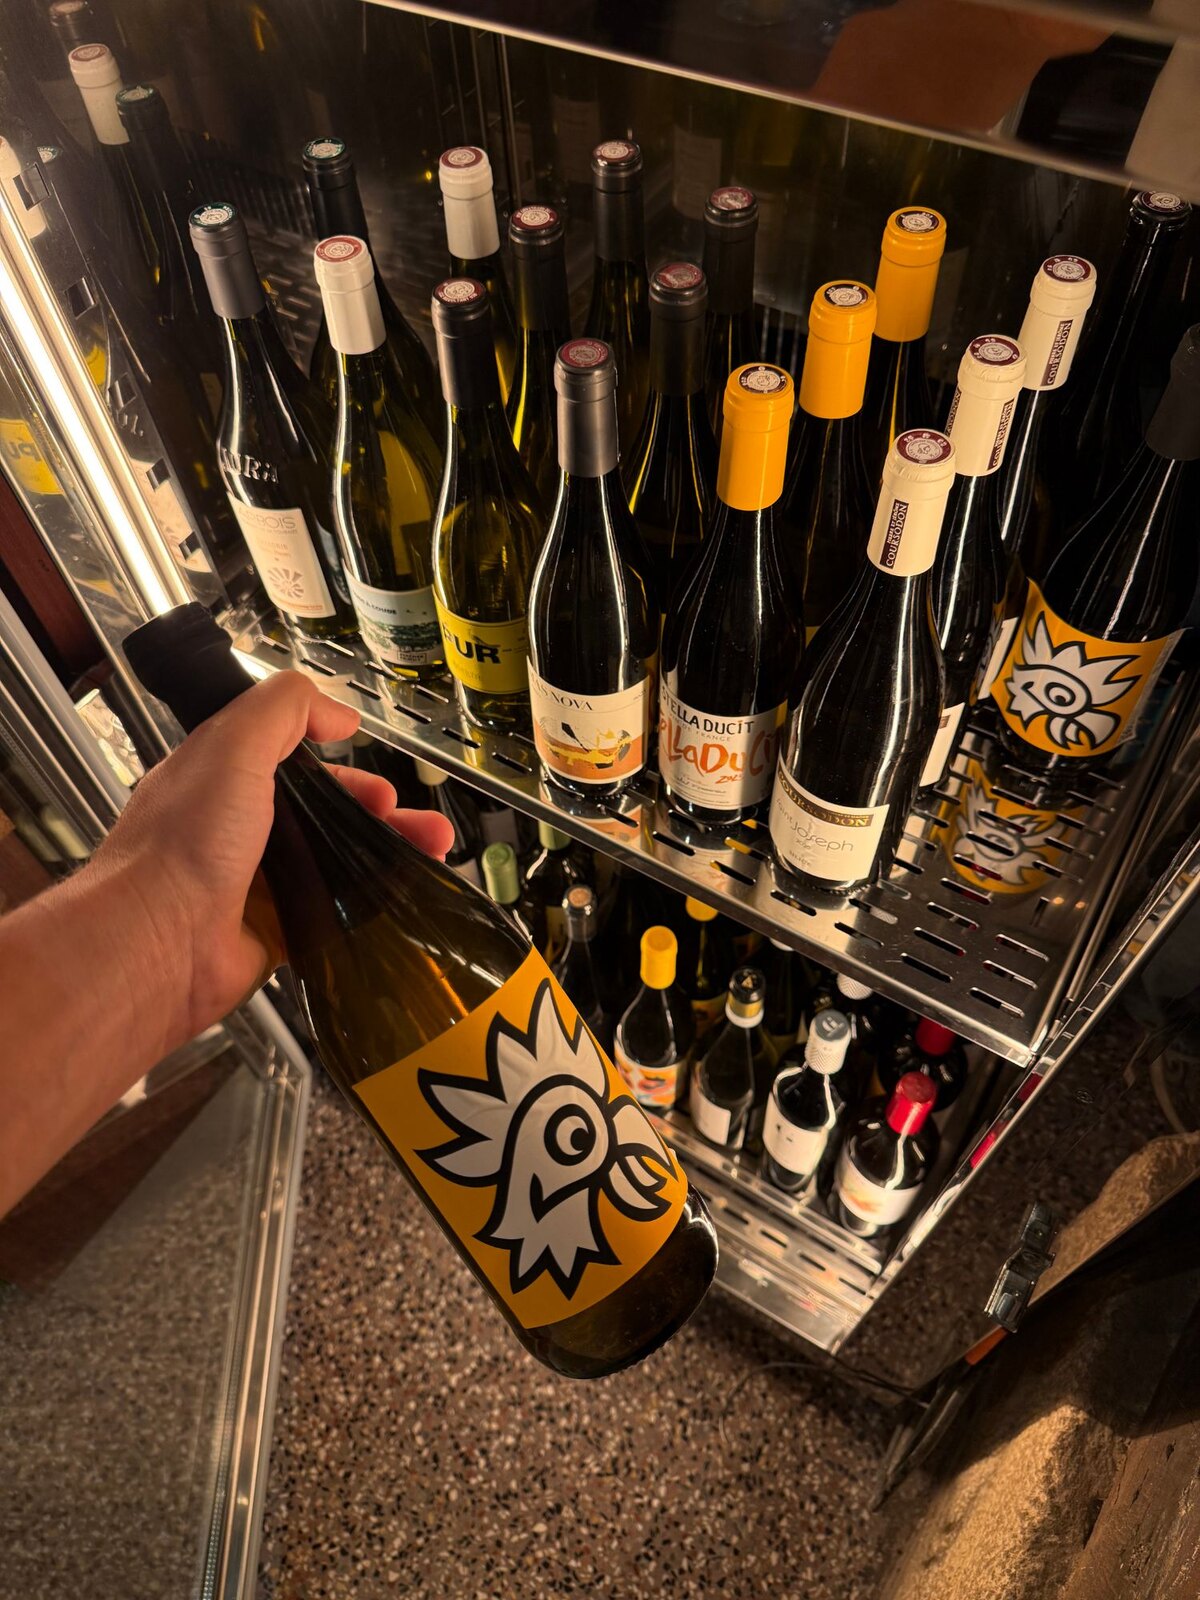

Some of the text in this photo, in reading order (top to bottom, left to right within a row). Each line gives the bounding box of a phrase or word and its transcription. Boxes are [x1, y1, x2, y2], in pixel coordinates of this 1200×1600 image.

[1047, 322, 1072, 385] COURSODON
[886, 503, 908, 567] COURSODON
[550, 690, 594, 712] NOVA
[661, 685, 700, 730] STELLA
[791, 821, 854, 852] Joseph
